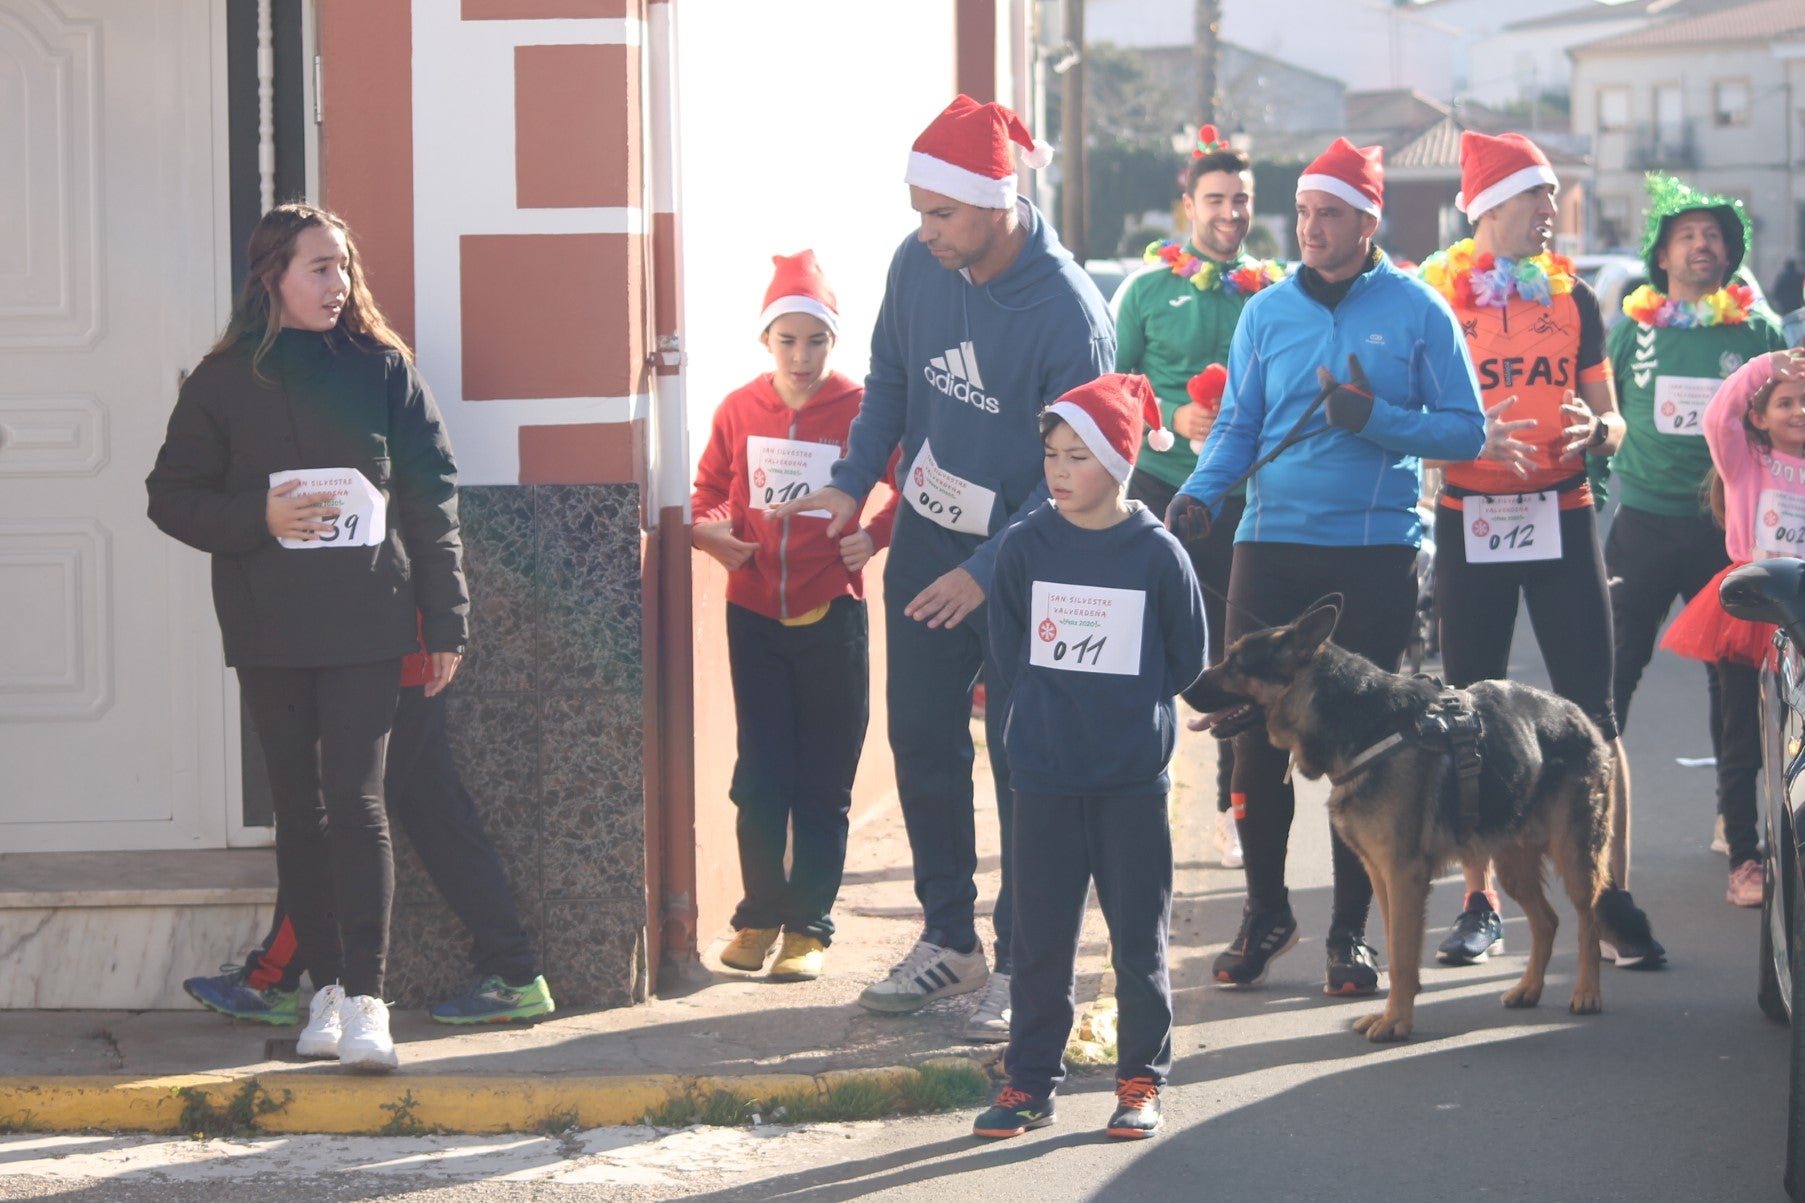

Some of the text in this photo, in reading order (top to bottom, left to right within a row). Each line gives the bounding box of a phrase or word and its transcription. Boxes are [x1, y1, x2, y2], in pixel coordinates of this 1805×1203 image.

[923, 366, 1000, 414] adidas
[919, 492, 962, 524] 009
[1489, 523, 1535, 551] 012
[1050, 594, 1113, 607] SAN SILVESTRE
[1053, 634, 1108, 666] 011
